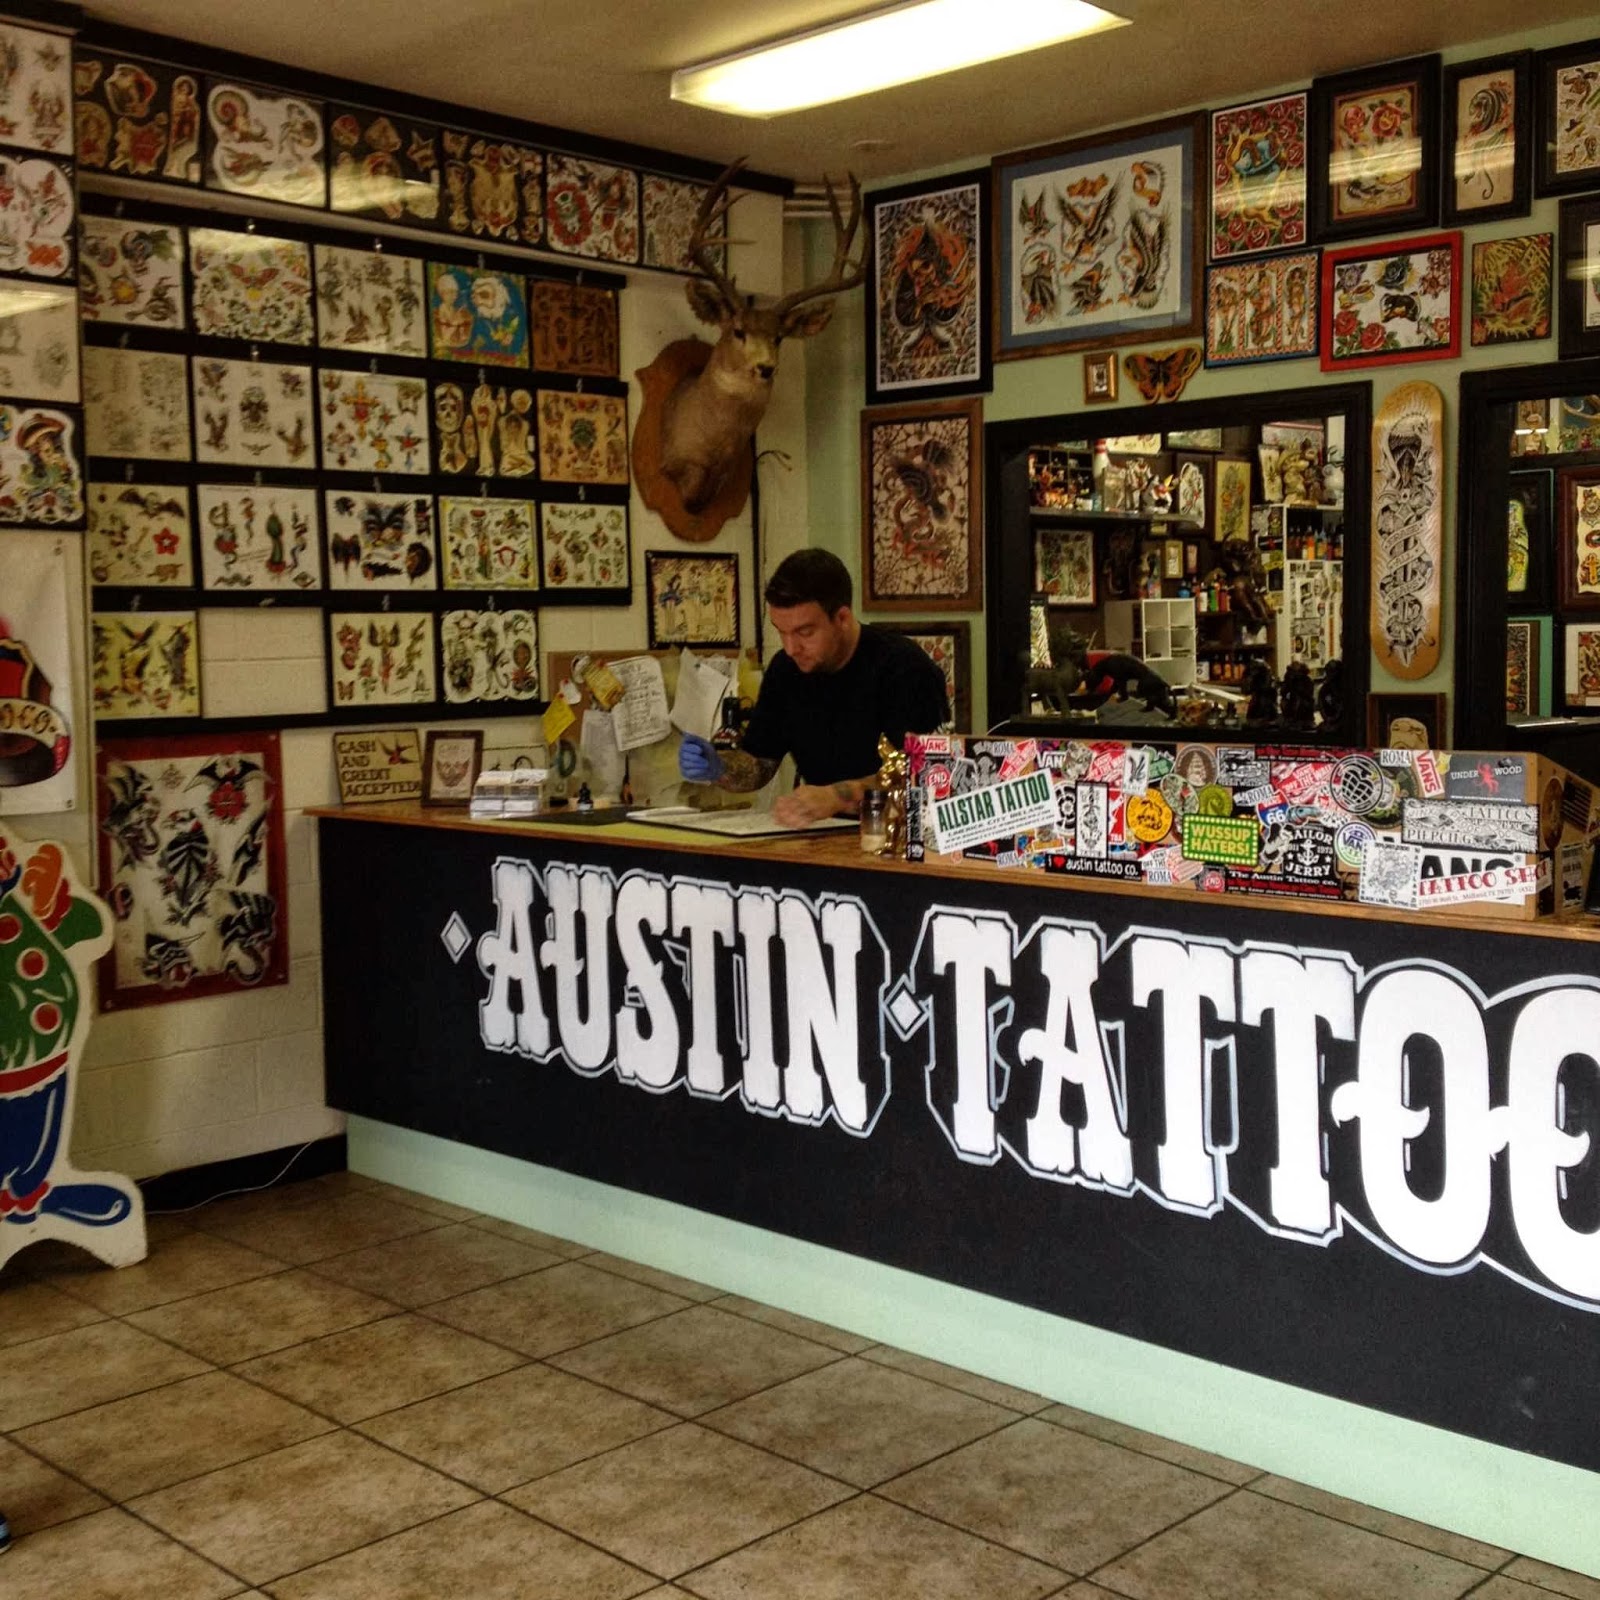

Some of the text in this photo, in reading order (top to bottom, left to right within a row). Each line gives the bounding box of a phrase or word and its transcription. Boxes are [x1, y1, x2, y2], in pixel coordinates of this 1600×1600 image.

[337, 740, 376, 753] CASH
[340, 755, 370, 767] AND
[1037, 752, 1066, 769] VAN
[1382, 751, 1411, 764] ROMA
[341, 768, 391, 782] CREDIT
[1417, 750, 1440, 793] VANS
[1450, 765, 1522, 780] UNDER WOOD
[1247, 786, 1274, 802] ROMA
[936, 790, 996, 832] ALLSTAR
[995, 773, 1051, 814] TATTOO
[1266, 808, 1286, 825] 66
[1190, 823, 1252, 842] WUSSUP
[1291, 829, 1333, 845] AILOR
[1191, 839, 1250, 857] HATERS!
[1342, 831, 1363, 851] VAN
[1066, 858, 1093, 871] austin
[1094, 860, 1123, 875] tattoo
[1124, 864, 1139, 876] co.
[1285, 862, 1331, 877] JERRY
[1148, 870, 1171, 882] ROMA
[1229, 870, 1249, 879] The
[1251, 872, 1284, 882] Austin
[1419, 871, 1497, 896] TATTOO
[479, 859, 872, 1134] AUSTIN
